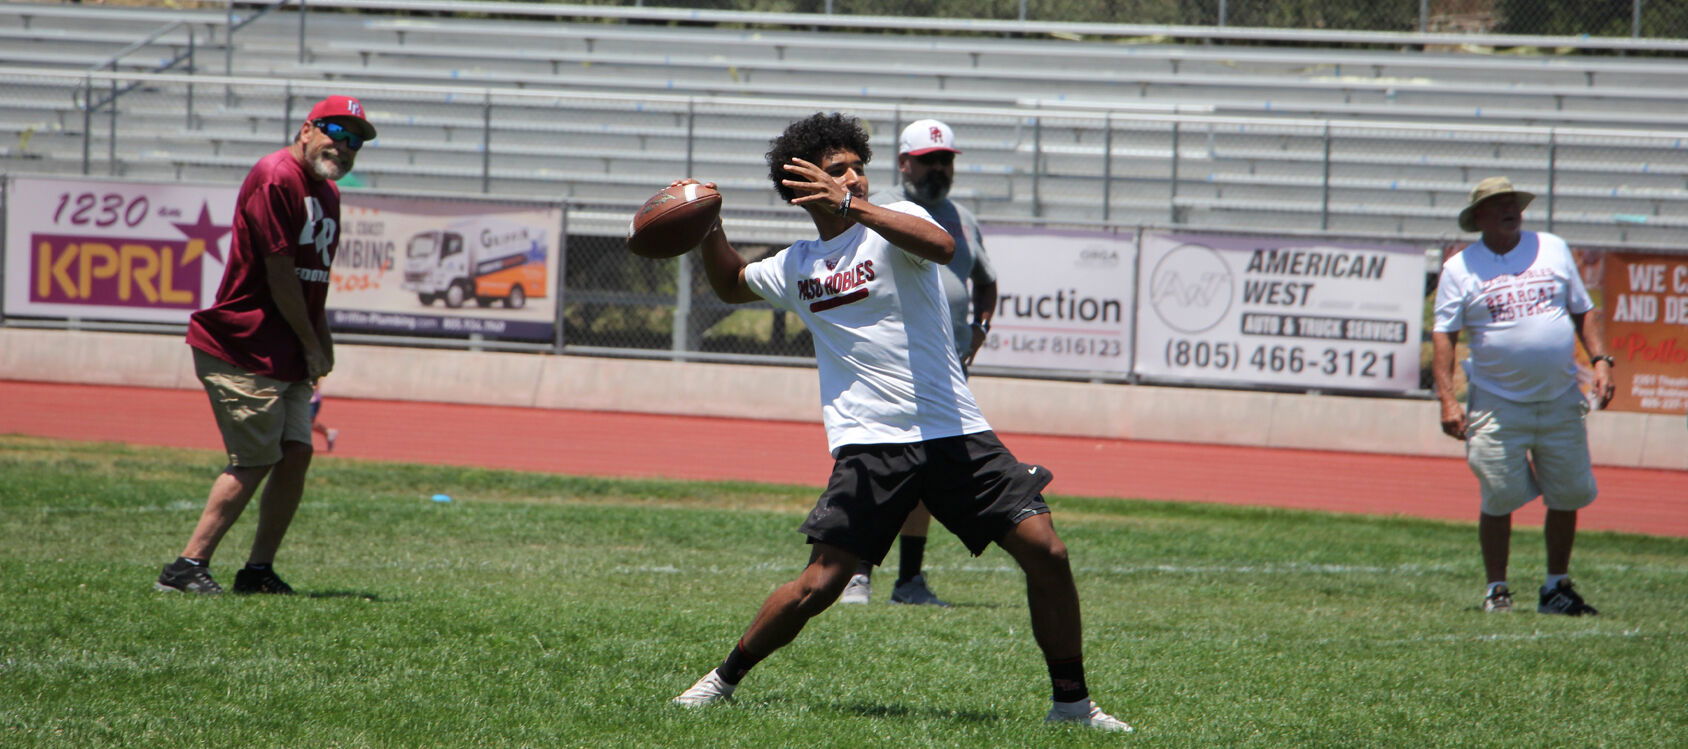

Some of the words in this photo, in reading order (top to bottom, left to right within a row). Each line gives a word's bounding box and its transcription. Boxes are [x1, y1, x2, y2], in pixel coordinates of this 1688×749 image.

[53, 193, 150, 228] 1230
[38, 241, 194, 303] KPRL
[824, 260, 875, 295] ROBLES
[1246, 248, 1387, 279] AMERICAN
[1627, 263, 1667, 293] WE
[1673, 264, 1688, 294] C
[998, 289, 1121, 323] ruction
[1242, 280, 1314, 306] WEST
[1486, 287, 1555, 309] BEARCAT
[1612, 293, 1659, 322] AND
[1244, 315, 1280, 334] AUTO
[1283, 316, 1295, 335] &
[1298, 317, 1343, 338] TRUCK
[1346, 319, 1405, 342] SERVICE
[1052, 336, 1121, 357] 816123
[1165, 339, 1240, 370] (805)
[1250, 346, 1396, 378] 466-3121
